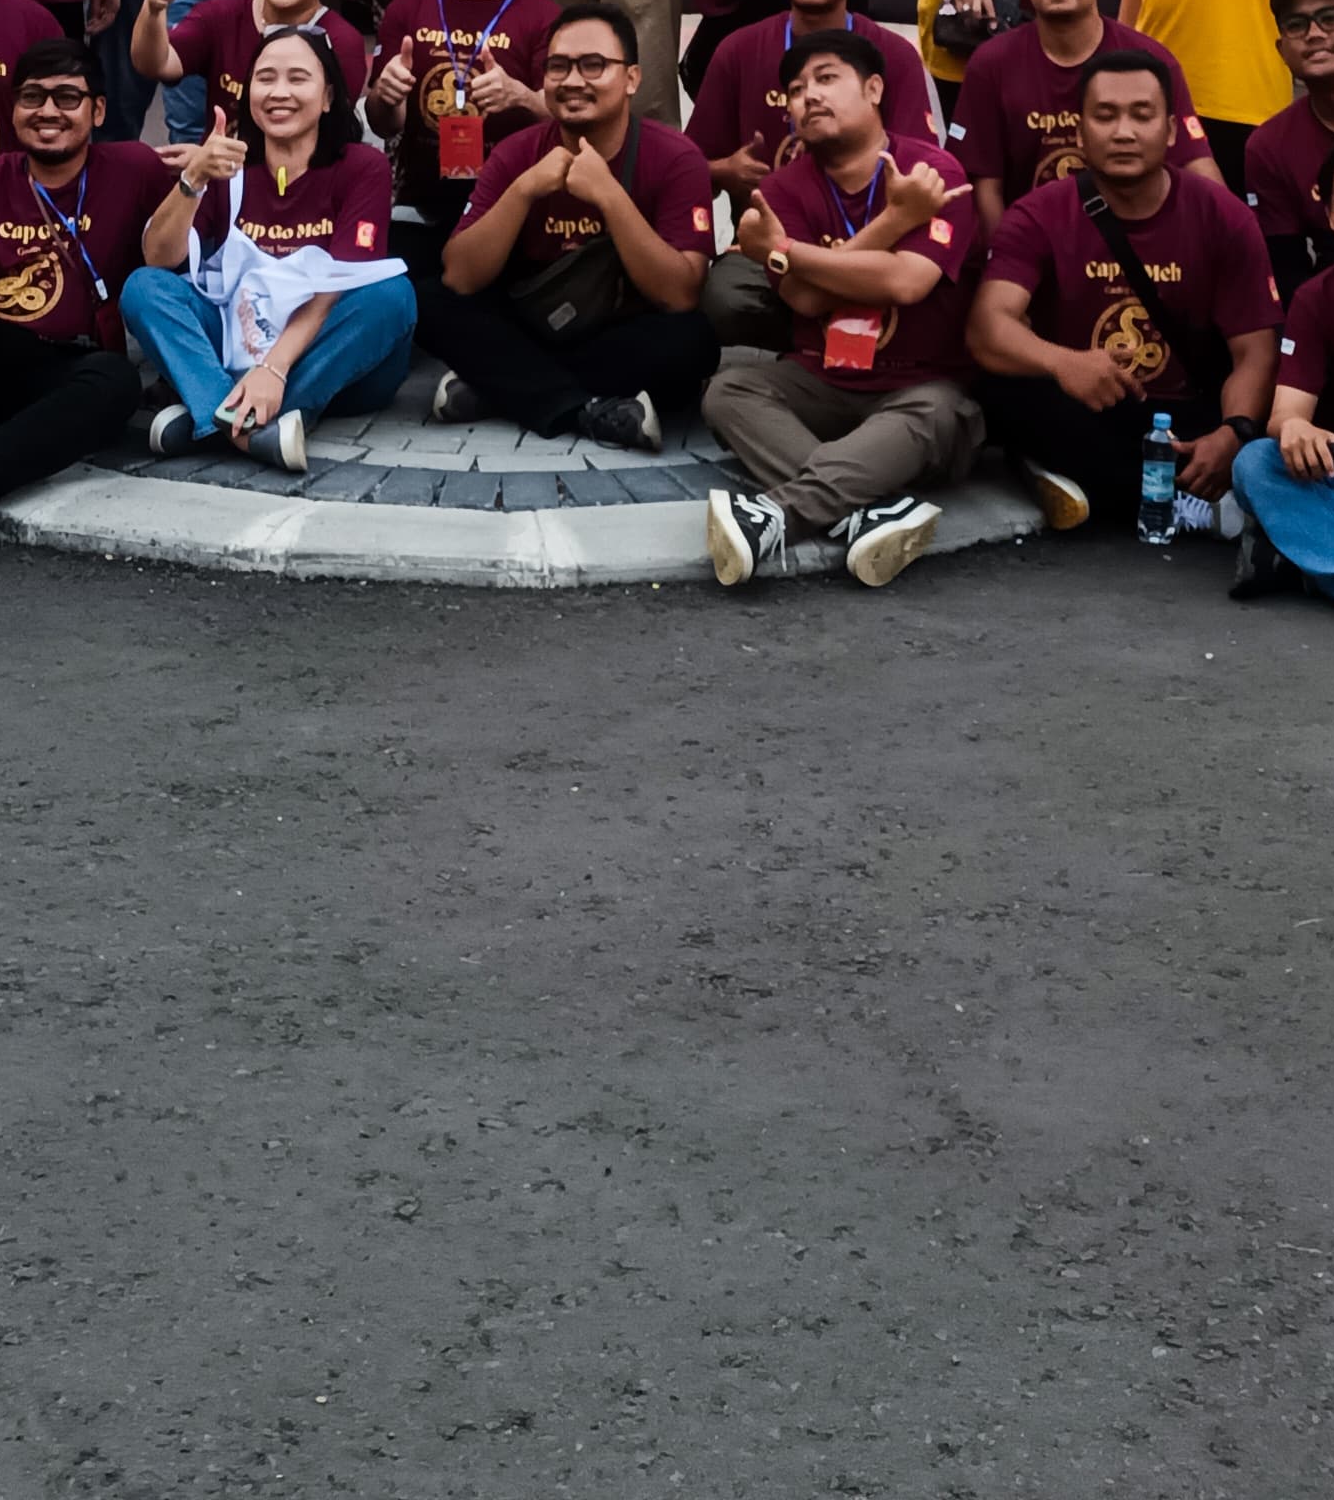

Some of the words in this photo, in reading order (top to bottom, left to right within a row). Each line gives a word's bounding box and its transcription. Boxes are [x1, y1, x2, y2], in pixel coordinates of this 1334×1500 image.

[766, 90, 787, 107] Ca
[1027, 112, 1056, 134] Cap
[0, 221, 35, 244] Cap
[268, 219, 294, 240] Go
[297, 218, 333, 239] Meh
[545, 217, 576, 239] Cap
[578, 217, 602, 234] Go
[1086, 261, 1120, 282] Cap
